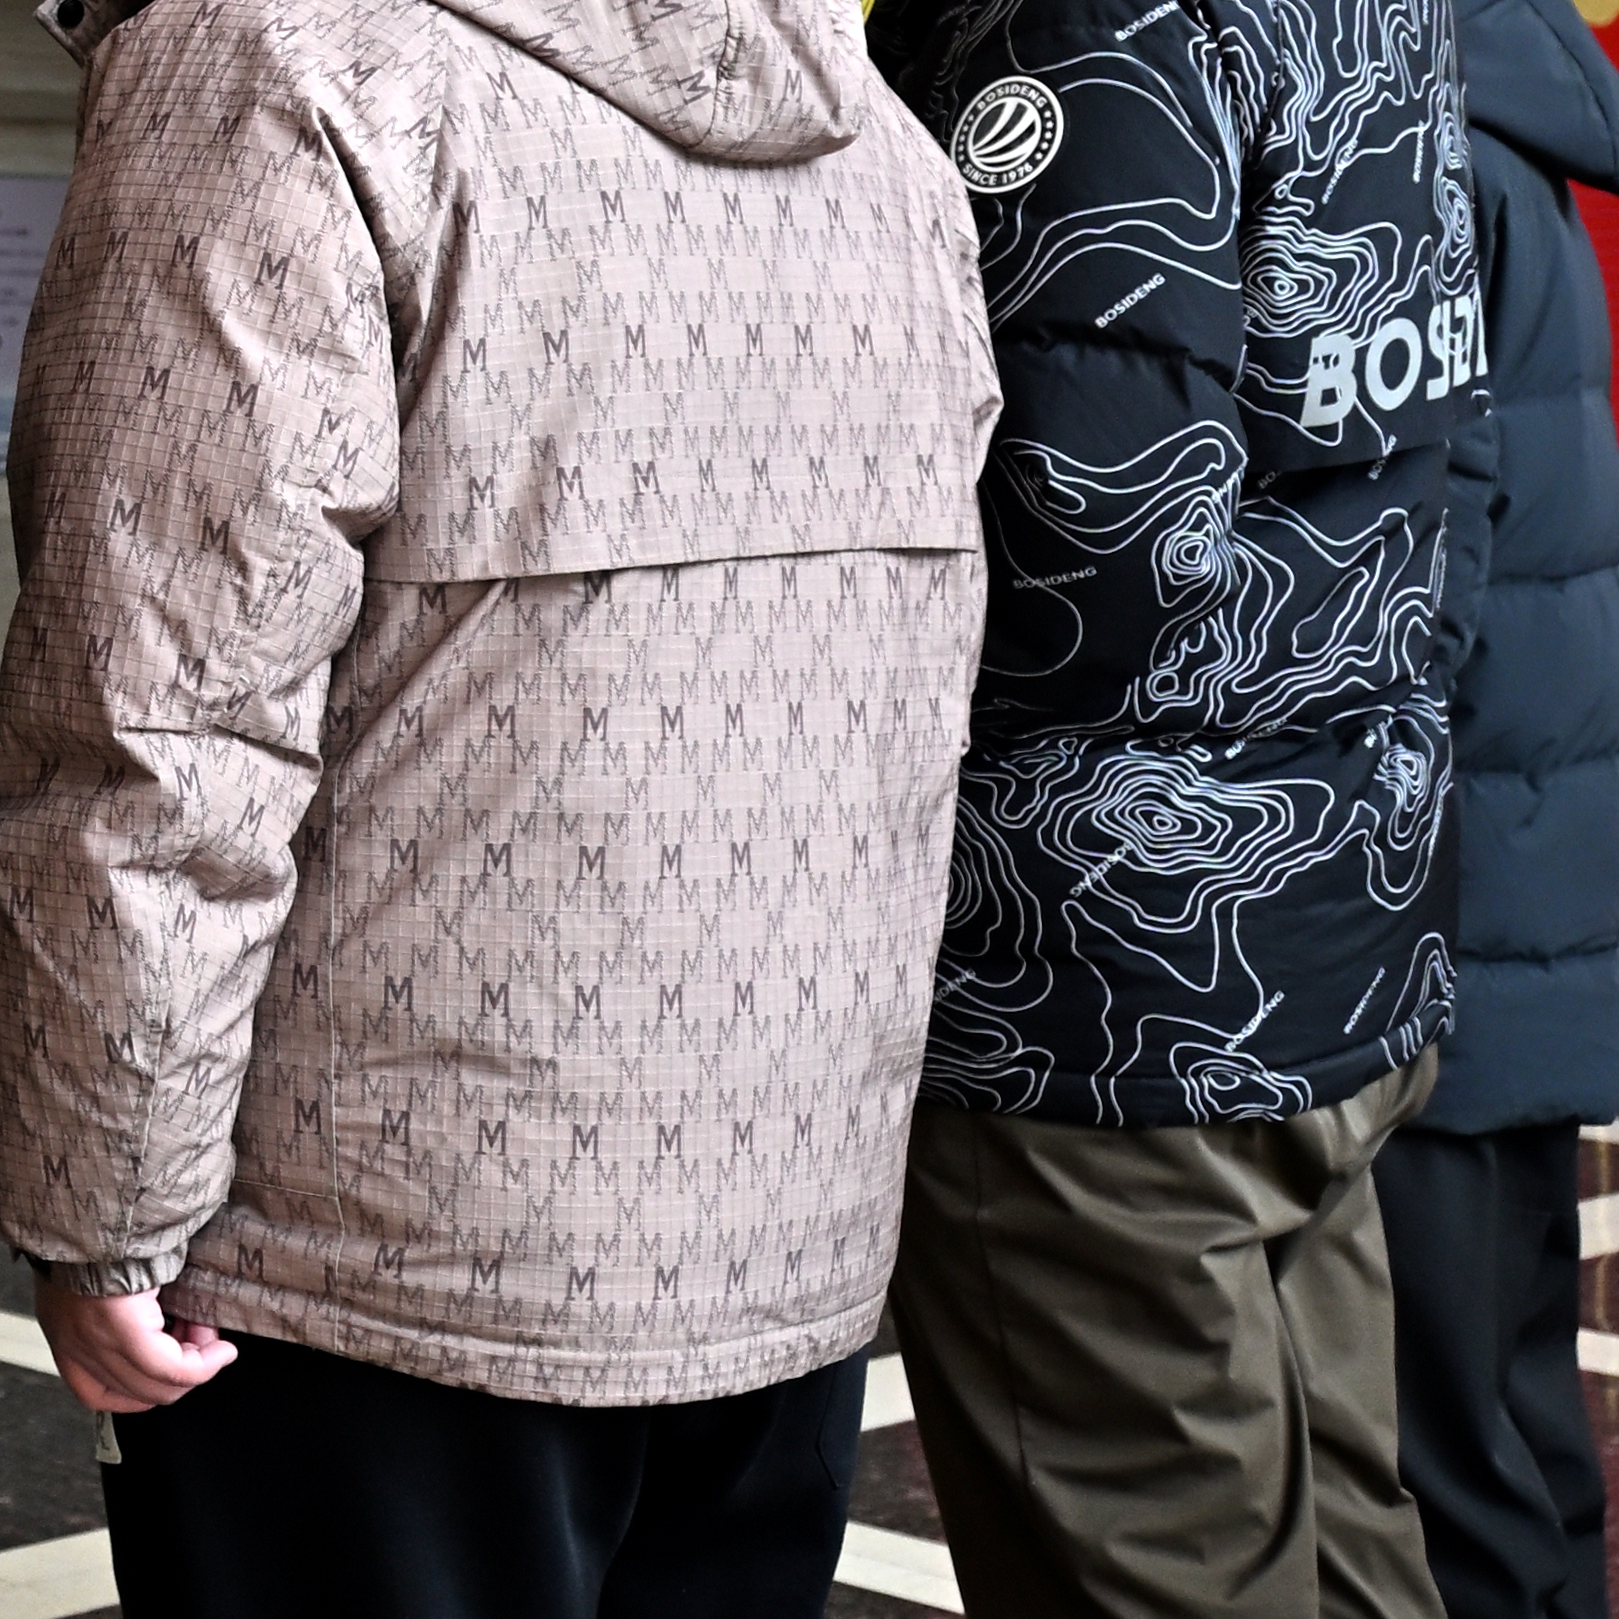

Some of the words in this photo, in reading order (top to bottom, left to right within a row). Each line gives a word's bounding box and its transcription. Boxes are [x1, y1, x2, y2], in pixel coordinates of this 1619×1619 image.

[976, 83, 1048, 111] BOSIDENG
[962, 163, 999, 186] SINCE
[1002, 161, 1035, 184] 1976
[456, 198, 481, 234] M
[526, 196, 546, 229] M
[601, 190, 625, 223] M
[665, 192, 683, 224] M
[725, 193, 743, 224] M
[777, 195, 794, 228] M
[826, 196, 842, 229] M
[1094, 272, 1166, 329] BOSIDENG
[463, 337, 487, 372] M
[544, 331, 566, 366] M
[626, 324, 646, 358] M
[688, 324, 705, 357] M
[748, 324, 765, 357] M
[796, 324, 812, 357] M
[854, 324, 873, 357] M
[469, 478, 494, 510] M
[557, 467, 586, 500] M
[633, 462, 661, 496] M
[703, 458, 719, 492] M
[752, 459, 770, 492] M
[810, 457, 828, 490] M
[866, 455, 882, 489] M
[918, 453, 938, 488] M
[422, 583, 447, 616] M
[586, 572, 612, 604] M
[663, 568, 680, 601] M
[724, 568, 739, 601] M
[783, 567, 798, 599] M
[841, 568, 856, 599] M
[887, 567, 902, 599] M
[928, 568, 946, 600] M
[1013, 566, 1098, 590] BOSIDENG
[398, 705, 423, 740] M
[489, 705, 518, 740] M
[581, 707, 607, 744] M
[661, 705, 683, 740] M
[724, 703, 743, 737] M
[787, 701, 803, 736] M
[849, 701, 867, 737] M
[895, 700, 908, 737] M
[304, 827, 327, 861] M
[392, 839, 420, 875] M
[485, 843, 510, 878] M
[577, 846, 606, 881] M
[660, 844, 682, 880] M
[732, 841, 750, 875] M
[795, 838, 809, 873] M
[854, 837, 870, 871] M
[292, 965, 318, 1001] M
[383, 976, 413, 1013] M
[479, 982, 509, 1020] M
[575, 985, 601, 1021] M
[658, 984, 683, 1023] M
[734, 981, 754, 1017] M
[799, 977, 817, 1013] M
[854, 973, 871, 1007] M
[295, 1100, 321, 1138] M
[382, 1110, 412, 1147] M
[477, 1119, 506, 1157] M
[569, 1125, 599, 1161] M
[657, 1123, 681, 1155] M
[734, 1119, 754, 1156] M
[795, 1113, 812, 1150] M
[375, 1246, 404, 1278] M
[471, 1256, 504, 1285] M
[566, 1267, 596, 1302] M
[654, 1264, 680, 1302] M
[727, 1259, 747, 1297] M
[784, 1251, 802, 1285] M
